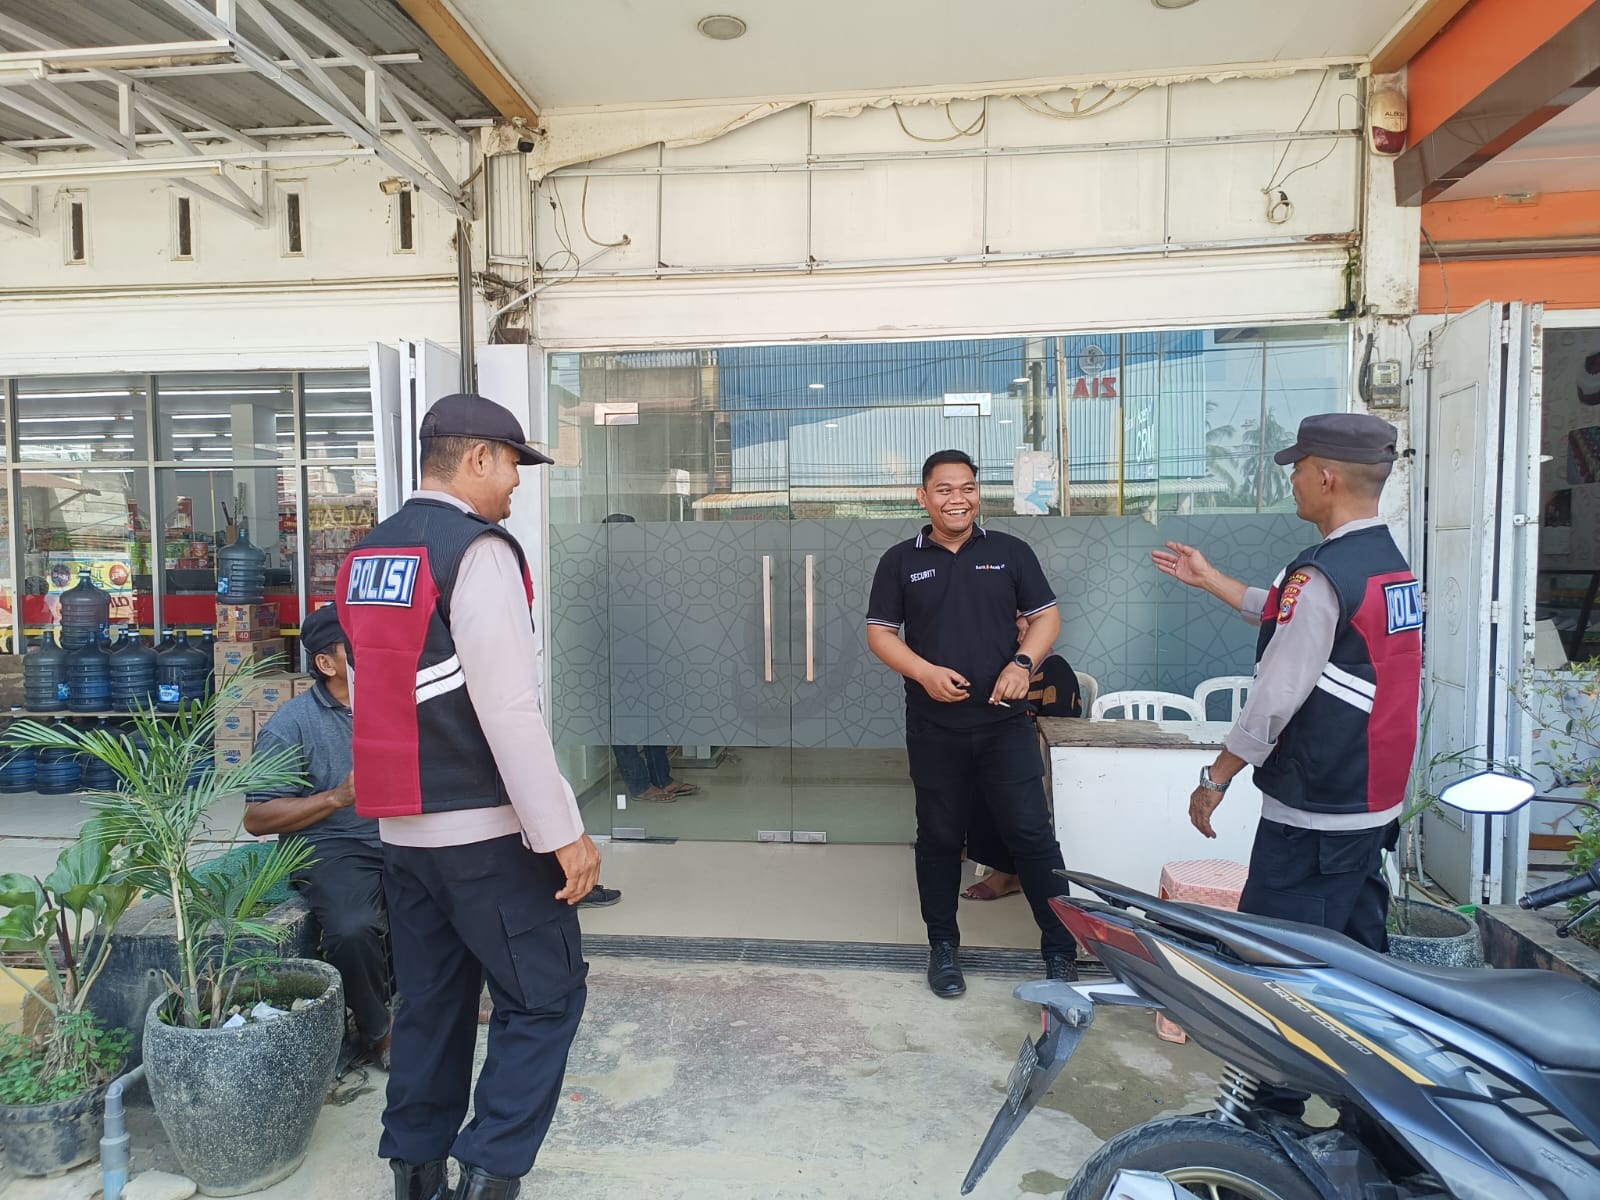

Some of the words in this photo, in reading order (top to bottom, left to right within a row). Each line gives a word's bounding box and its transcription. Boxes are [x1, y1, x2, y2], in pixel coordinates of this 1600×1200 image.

[350, 558, 416, 601] POLISI
[910, 568, 936, 583] SECURITY
[239, 631, 249, 640] 40
[1263, 982, 1311, 1013] LIQUID
[1311, 1015, 1373, 1055] COOLED
